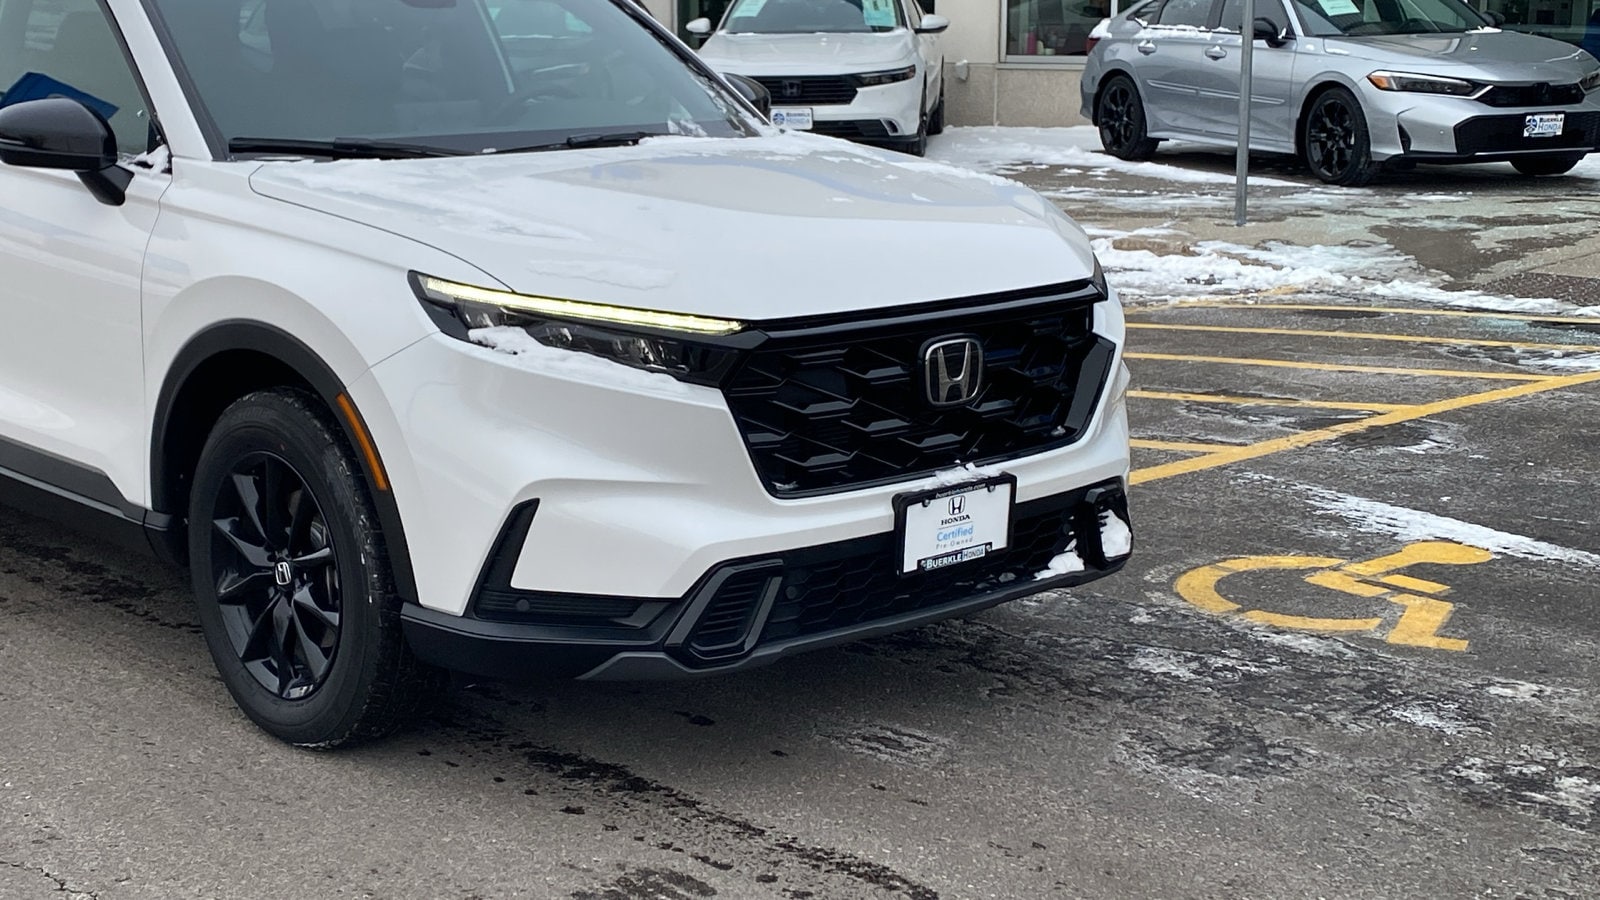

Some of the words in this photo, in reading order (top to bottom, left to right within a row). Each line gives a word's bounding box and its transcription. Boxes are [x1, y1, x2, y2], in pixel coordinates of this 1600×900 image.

[941, 514, 971, 525] HONDA
[937, 525, 974, 541] Certified
[926, 553, 963, 569] BUERKLE
[962, 546, 984, 560] HONDA
